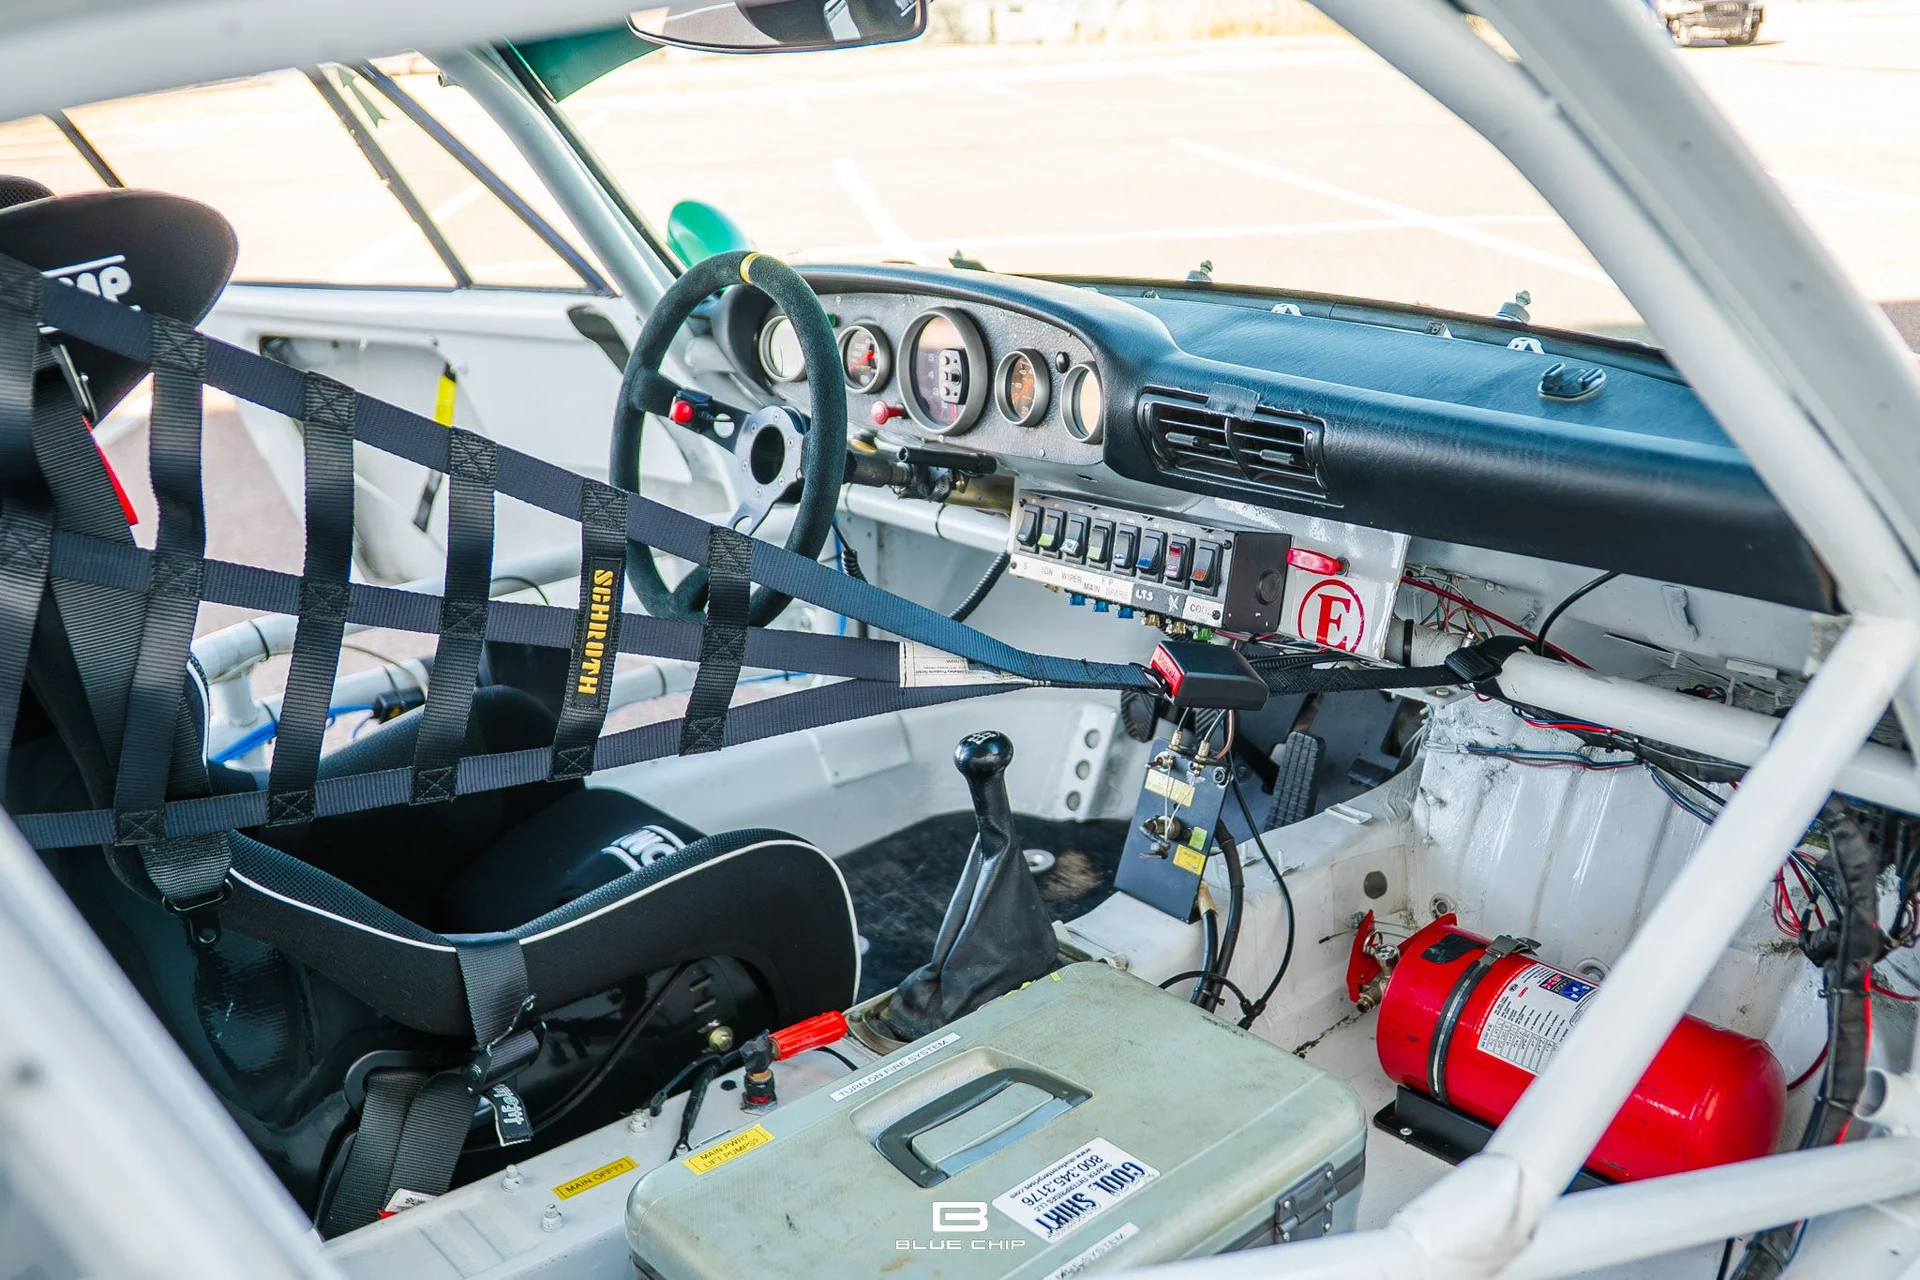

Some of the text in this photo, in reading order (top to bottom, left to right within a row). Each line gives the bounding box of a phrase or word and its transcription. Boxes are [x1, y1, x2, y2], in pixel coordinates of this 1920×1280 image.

[1041, 565, 1054, 576] IGN
[1061, 571, 1082, 586] WIPER
[1083, 582, 1101, 594] MAIN
[577, 569, 614, 695] SCHROTH
[1315, 592, 1352, 651] E
[840, 1040, 947, 1096] TURN ON FIRE SYSTEM
[700, 1146, 724, 1161] MAIN
[703, 1138, 759, 1168] LIFT PUMPS?
[565, 1177, 592, 1193] MAIN
[1021, 1154, 1104, 1206] 800.345.3176
[1046, 1177, 1090, 1204] ENTERPRISES
[1034, 1161, 1146, 1235] COOL SHIRT
